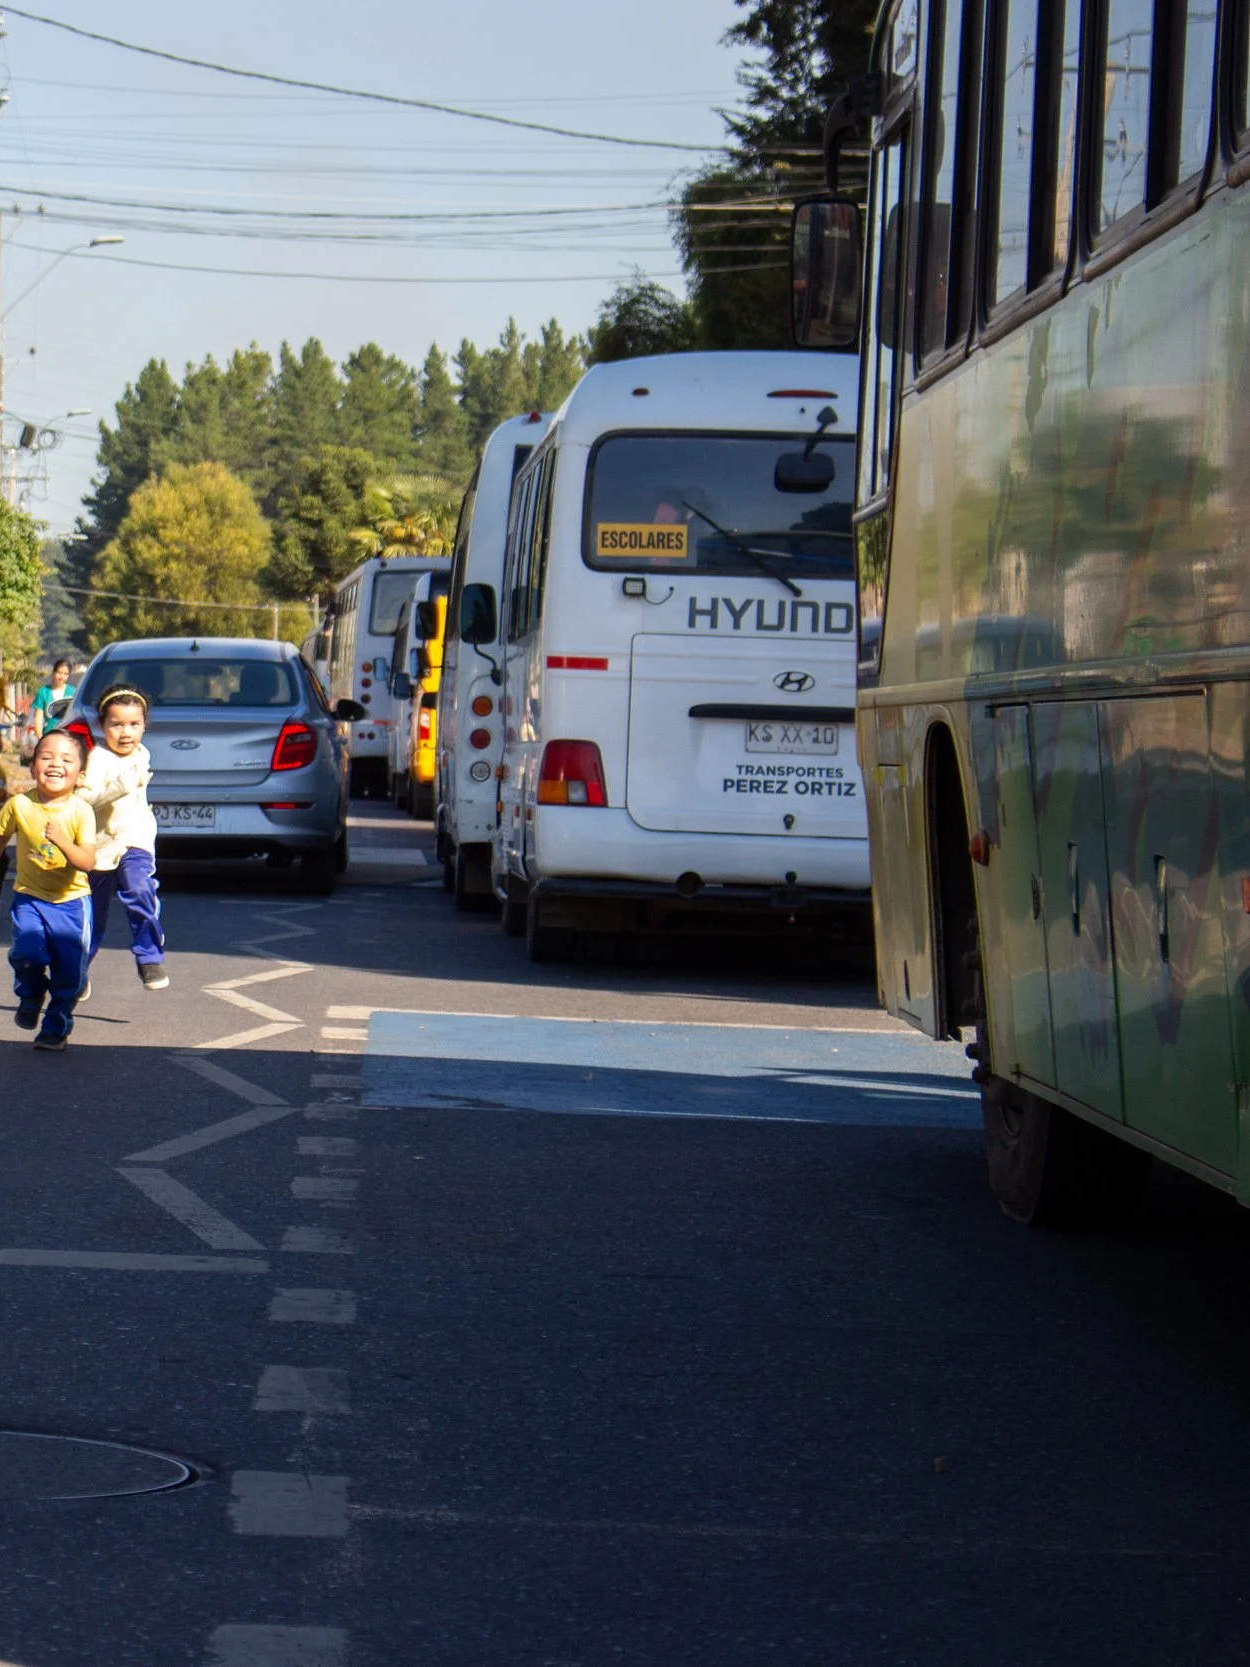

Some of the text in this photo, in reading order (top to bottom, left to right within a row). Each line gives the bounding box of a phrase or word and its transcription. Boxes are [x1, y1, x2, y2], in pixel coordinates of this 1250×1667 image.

[600, 529, 684, 551] ESCOLARES
[688, 596, 854, 633] HYUND
[736, 764, 845, 779] TRANSPORTES
[723, 778, 857, 797] PEREZ ORTIZ
